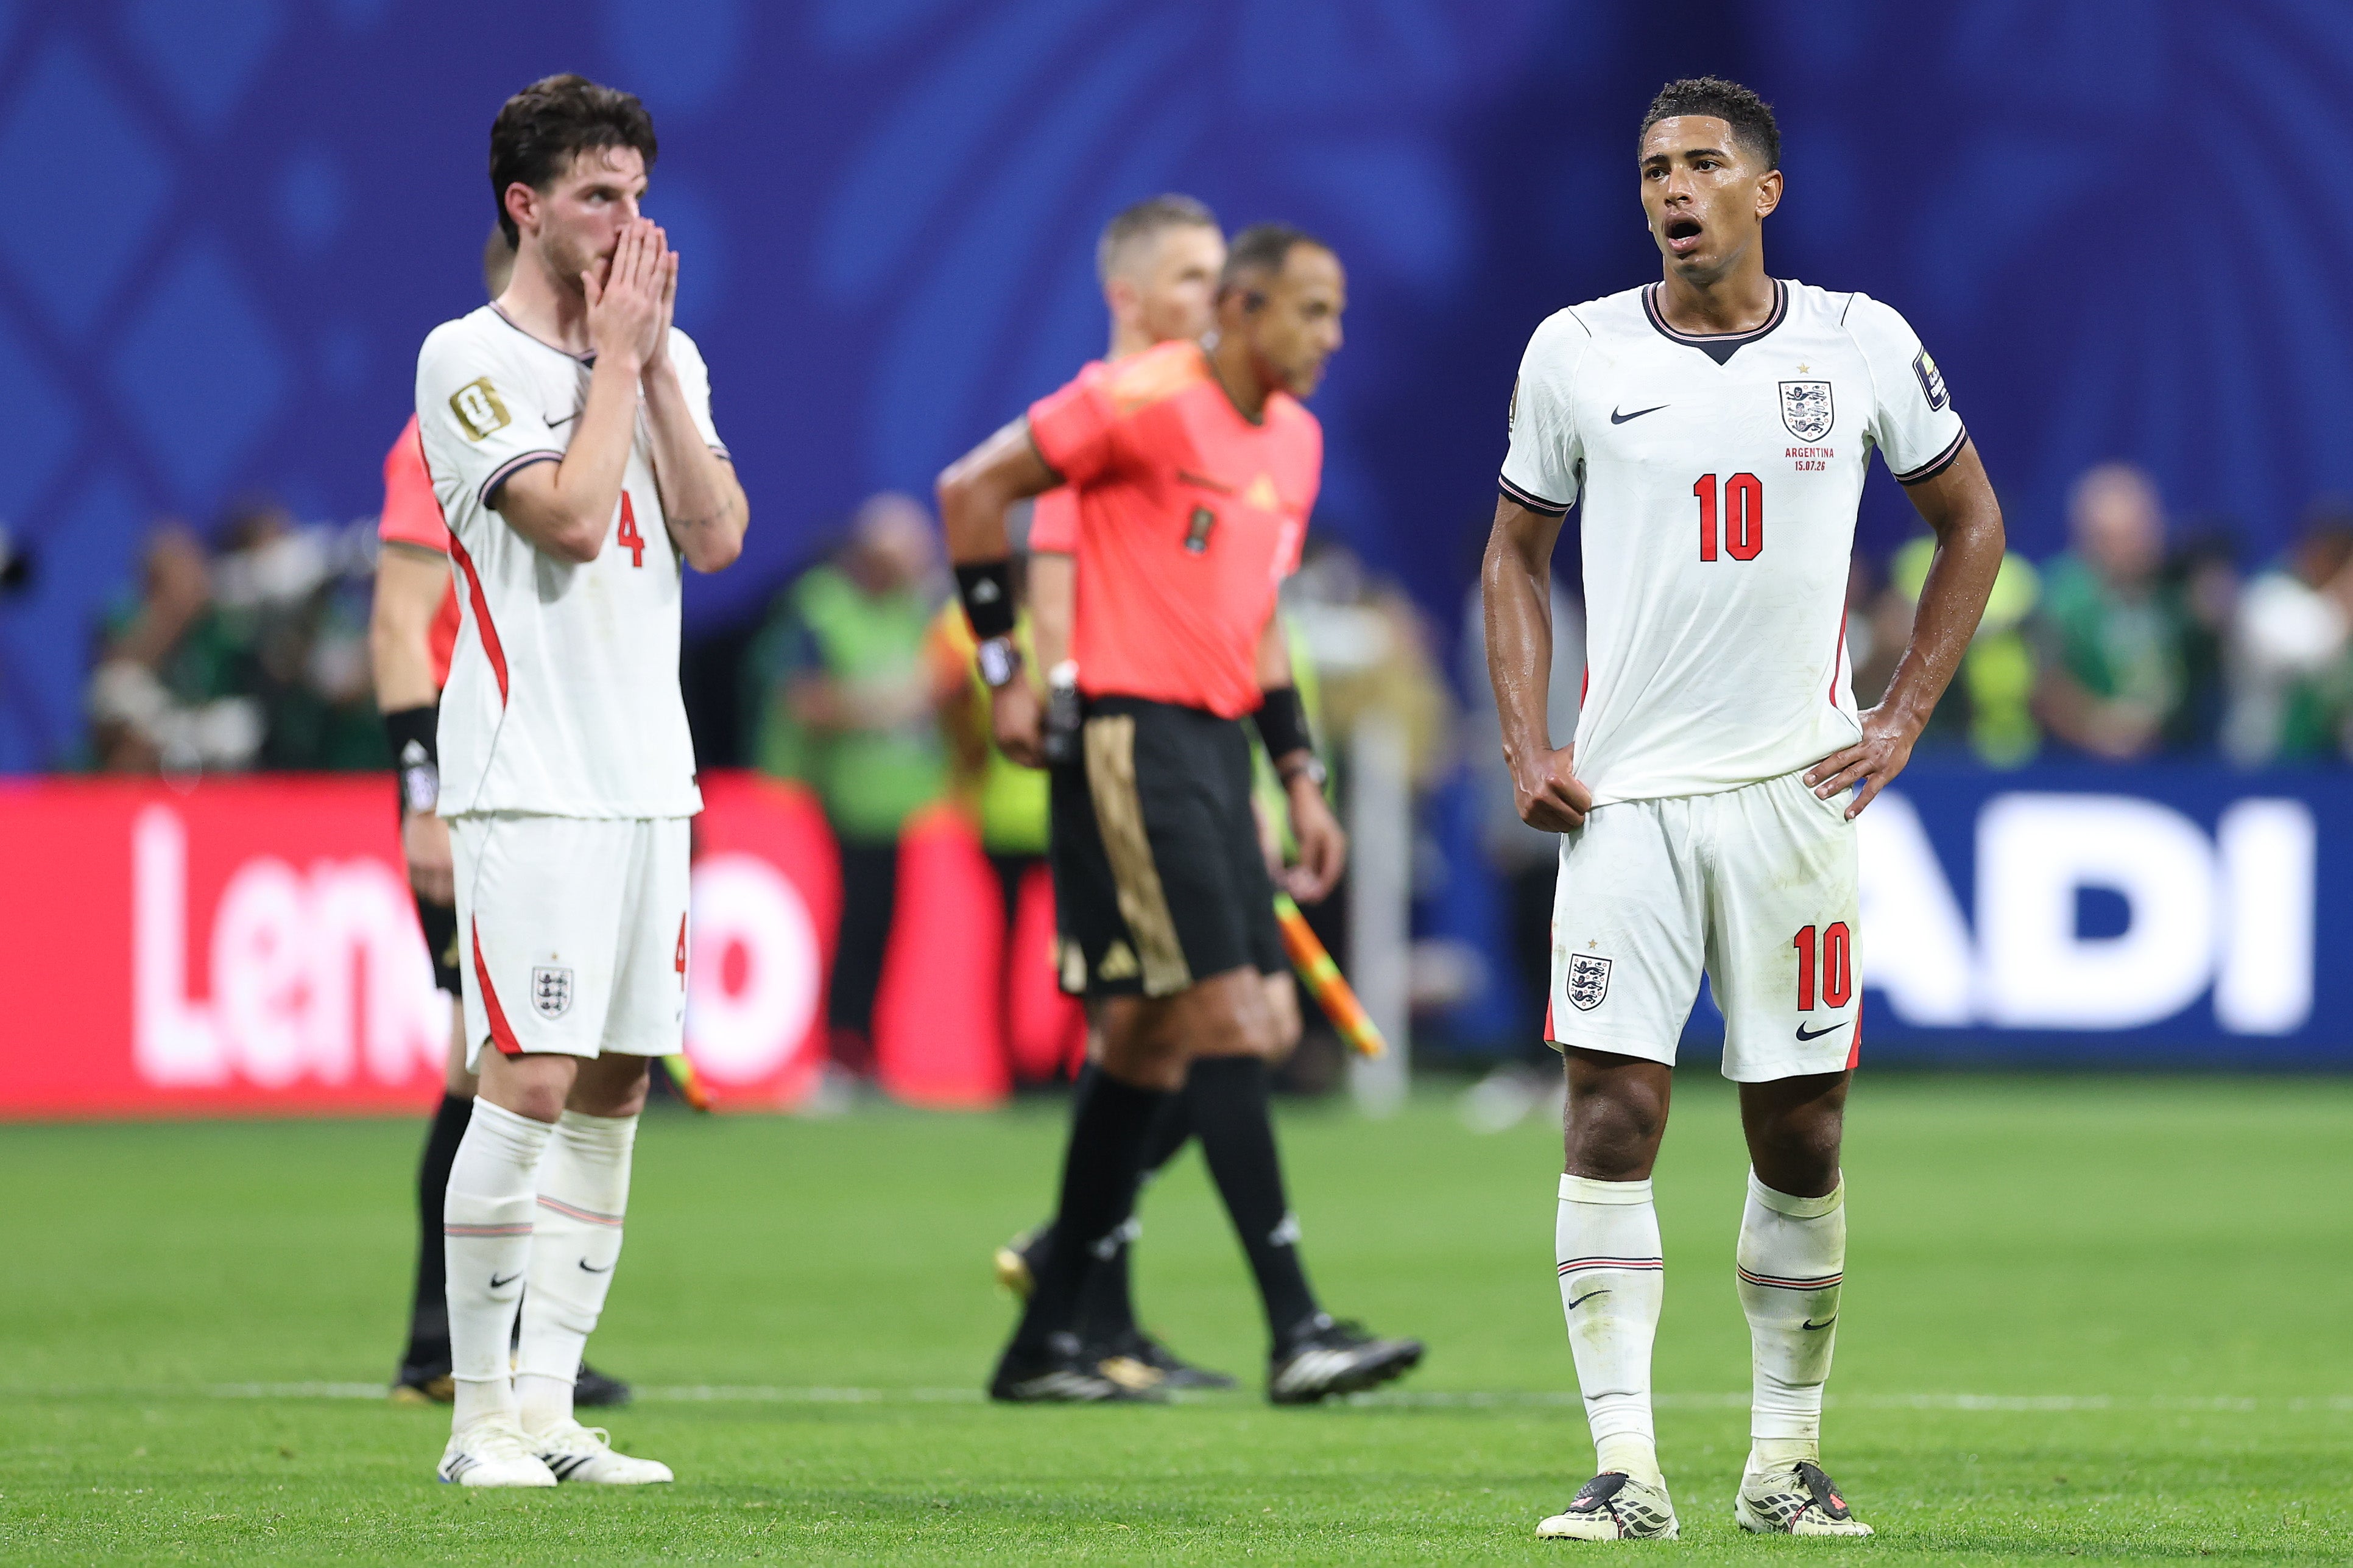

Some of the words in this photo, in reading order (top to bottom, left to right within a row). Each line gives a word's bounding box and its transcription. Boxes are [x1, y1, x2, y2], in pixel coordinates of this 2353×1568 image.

[1785, 448, 1834, 458] ARGENTINA
[1795, 461, 1826, 471] 15.07.26
[618, 490, 644, 567] 4
[1693, 473, 1763, 561] 10
[132, 802, 822, 1088] Leno
[1794, 921, 1852, 1011] 10
